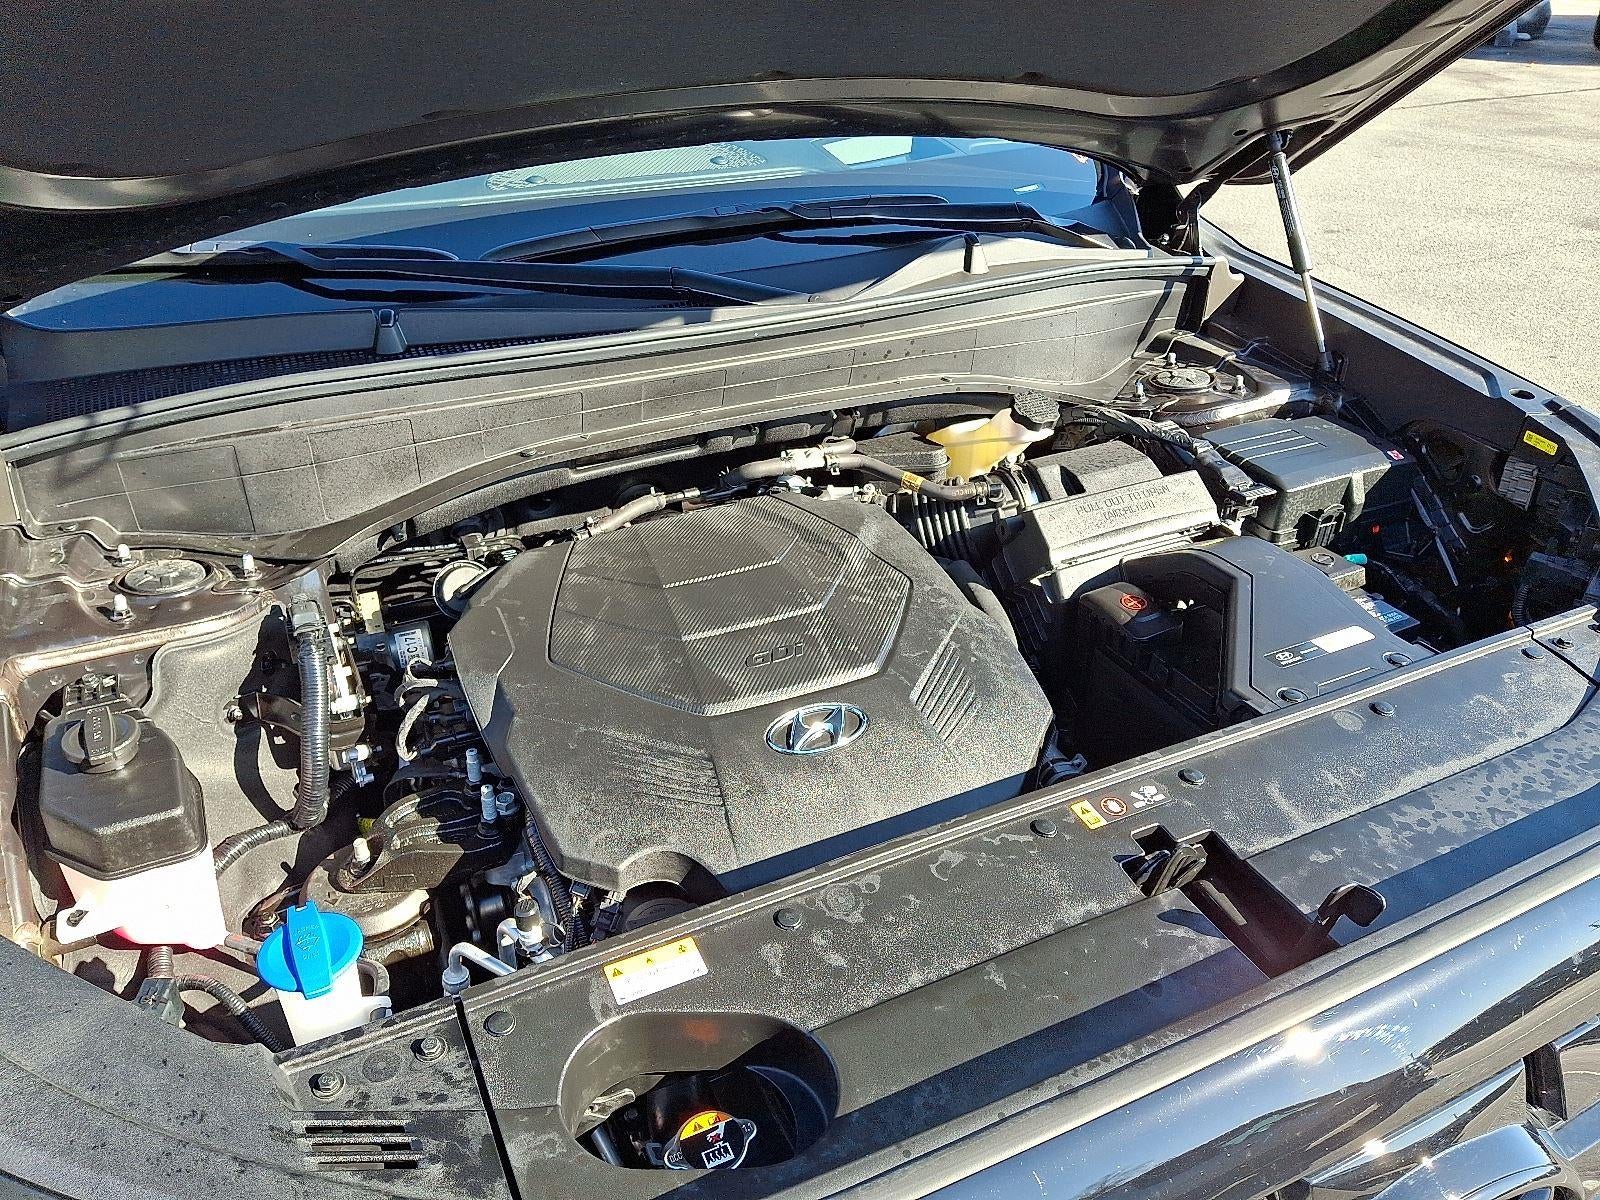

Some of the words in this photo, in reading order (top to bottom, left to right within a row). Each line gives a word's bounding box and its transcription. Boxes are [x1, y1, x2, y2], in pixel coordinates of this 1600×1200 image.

[1075, 502, 1103, 515] PULL
[1105, 495, 1126, 507] OUT
[1128, 491, 1142, 501] TO
[1142, 484, 1170, 497] OPEN
[404, 637, 418, 654] C17
